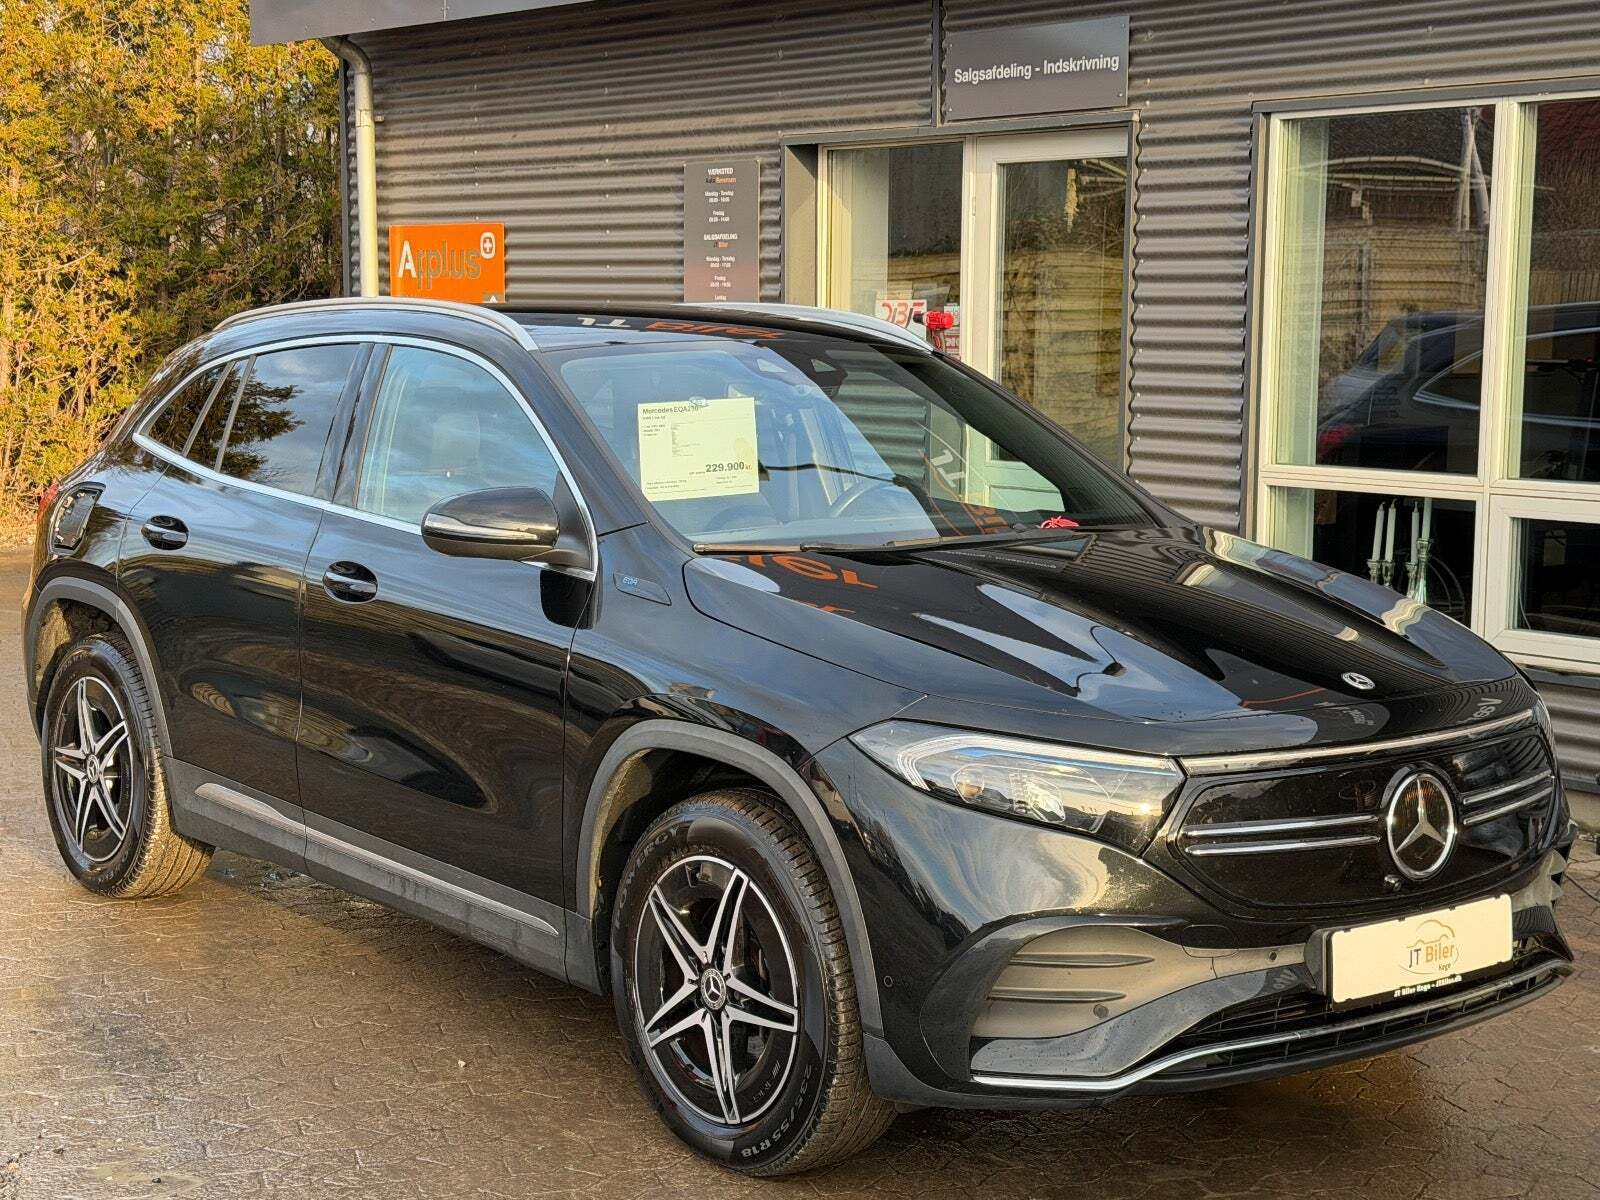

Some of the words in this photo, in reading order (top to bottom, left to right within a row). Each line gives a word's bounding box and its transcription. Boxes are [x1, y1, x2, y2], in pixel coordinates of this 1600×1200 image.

[954, 63, 1032, 85] Salgsafdeling
[1043, 54, 1120, 75] Indskrivning
[642, 407, 673, 415] Mercedes
[705, 461, 745, 473] 229.900
[1408, 948, 1421, 968] JT
[1425, 943, 1455, 963] Biler
